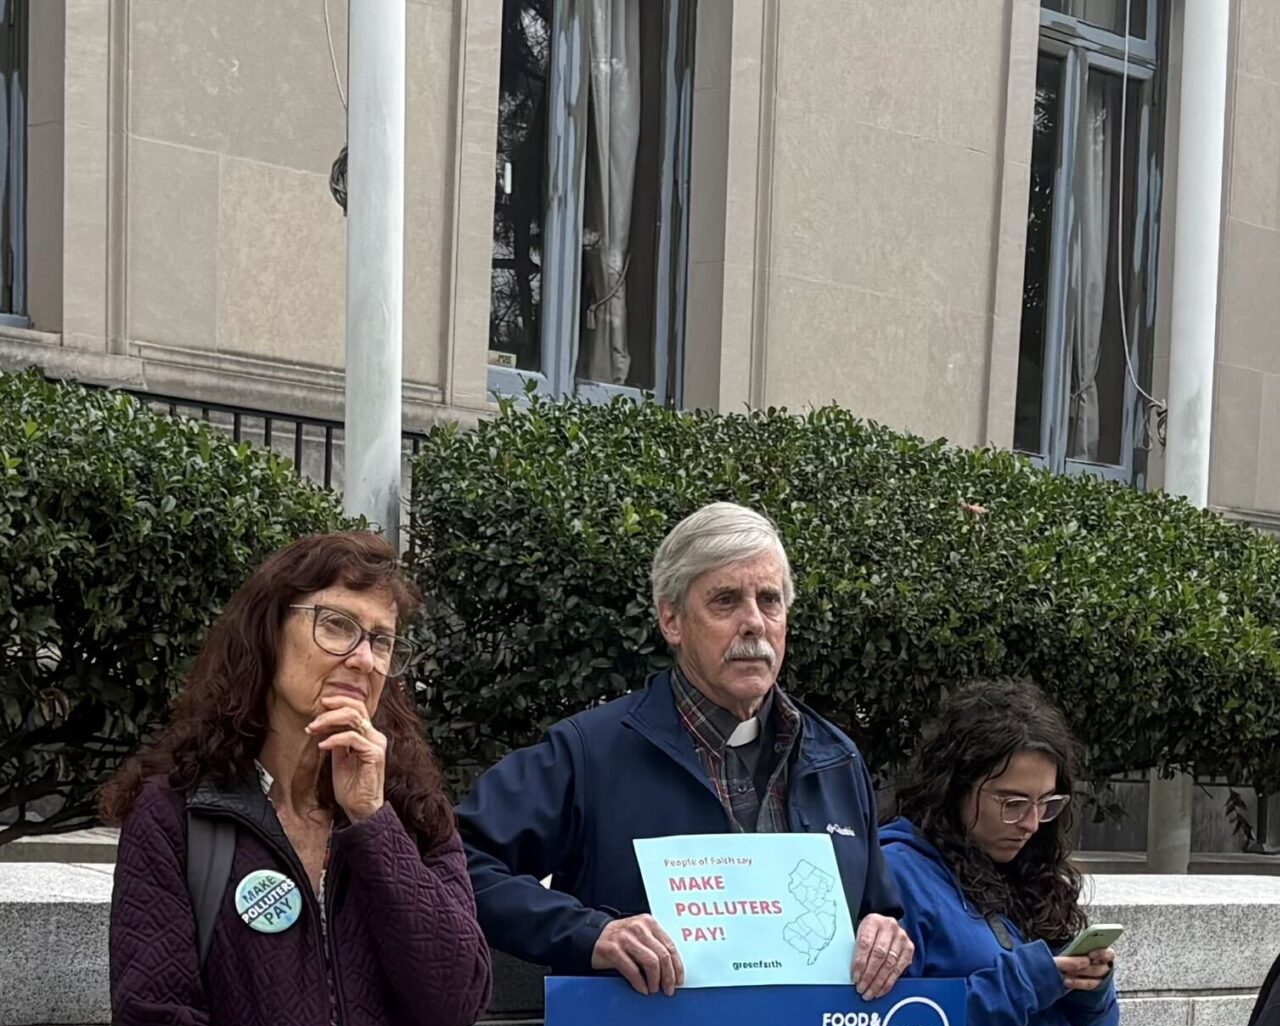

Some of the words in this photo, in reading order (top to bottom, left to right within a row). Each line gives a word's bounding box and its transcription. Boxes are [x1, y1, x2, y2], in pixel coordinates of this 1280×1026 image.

[242, 875, 277, 904] MAKE
[668, 875, 725, 891] MAKE
[241, 878, 296, 924] POLLUTERS
[263, 897, 293, 926] PAY
[675, 900, 783, 917] POLLUTERS
[681, 926, 726, 942] PAY!
